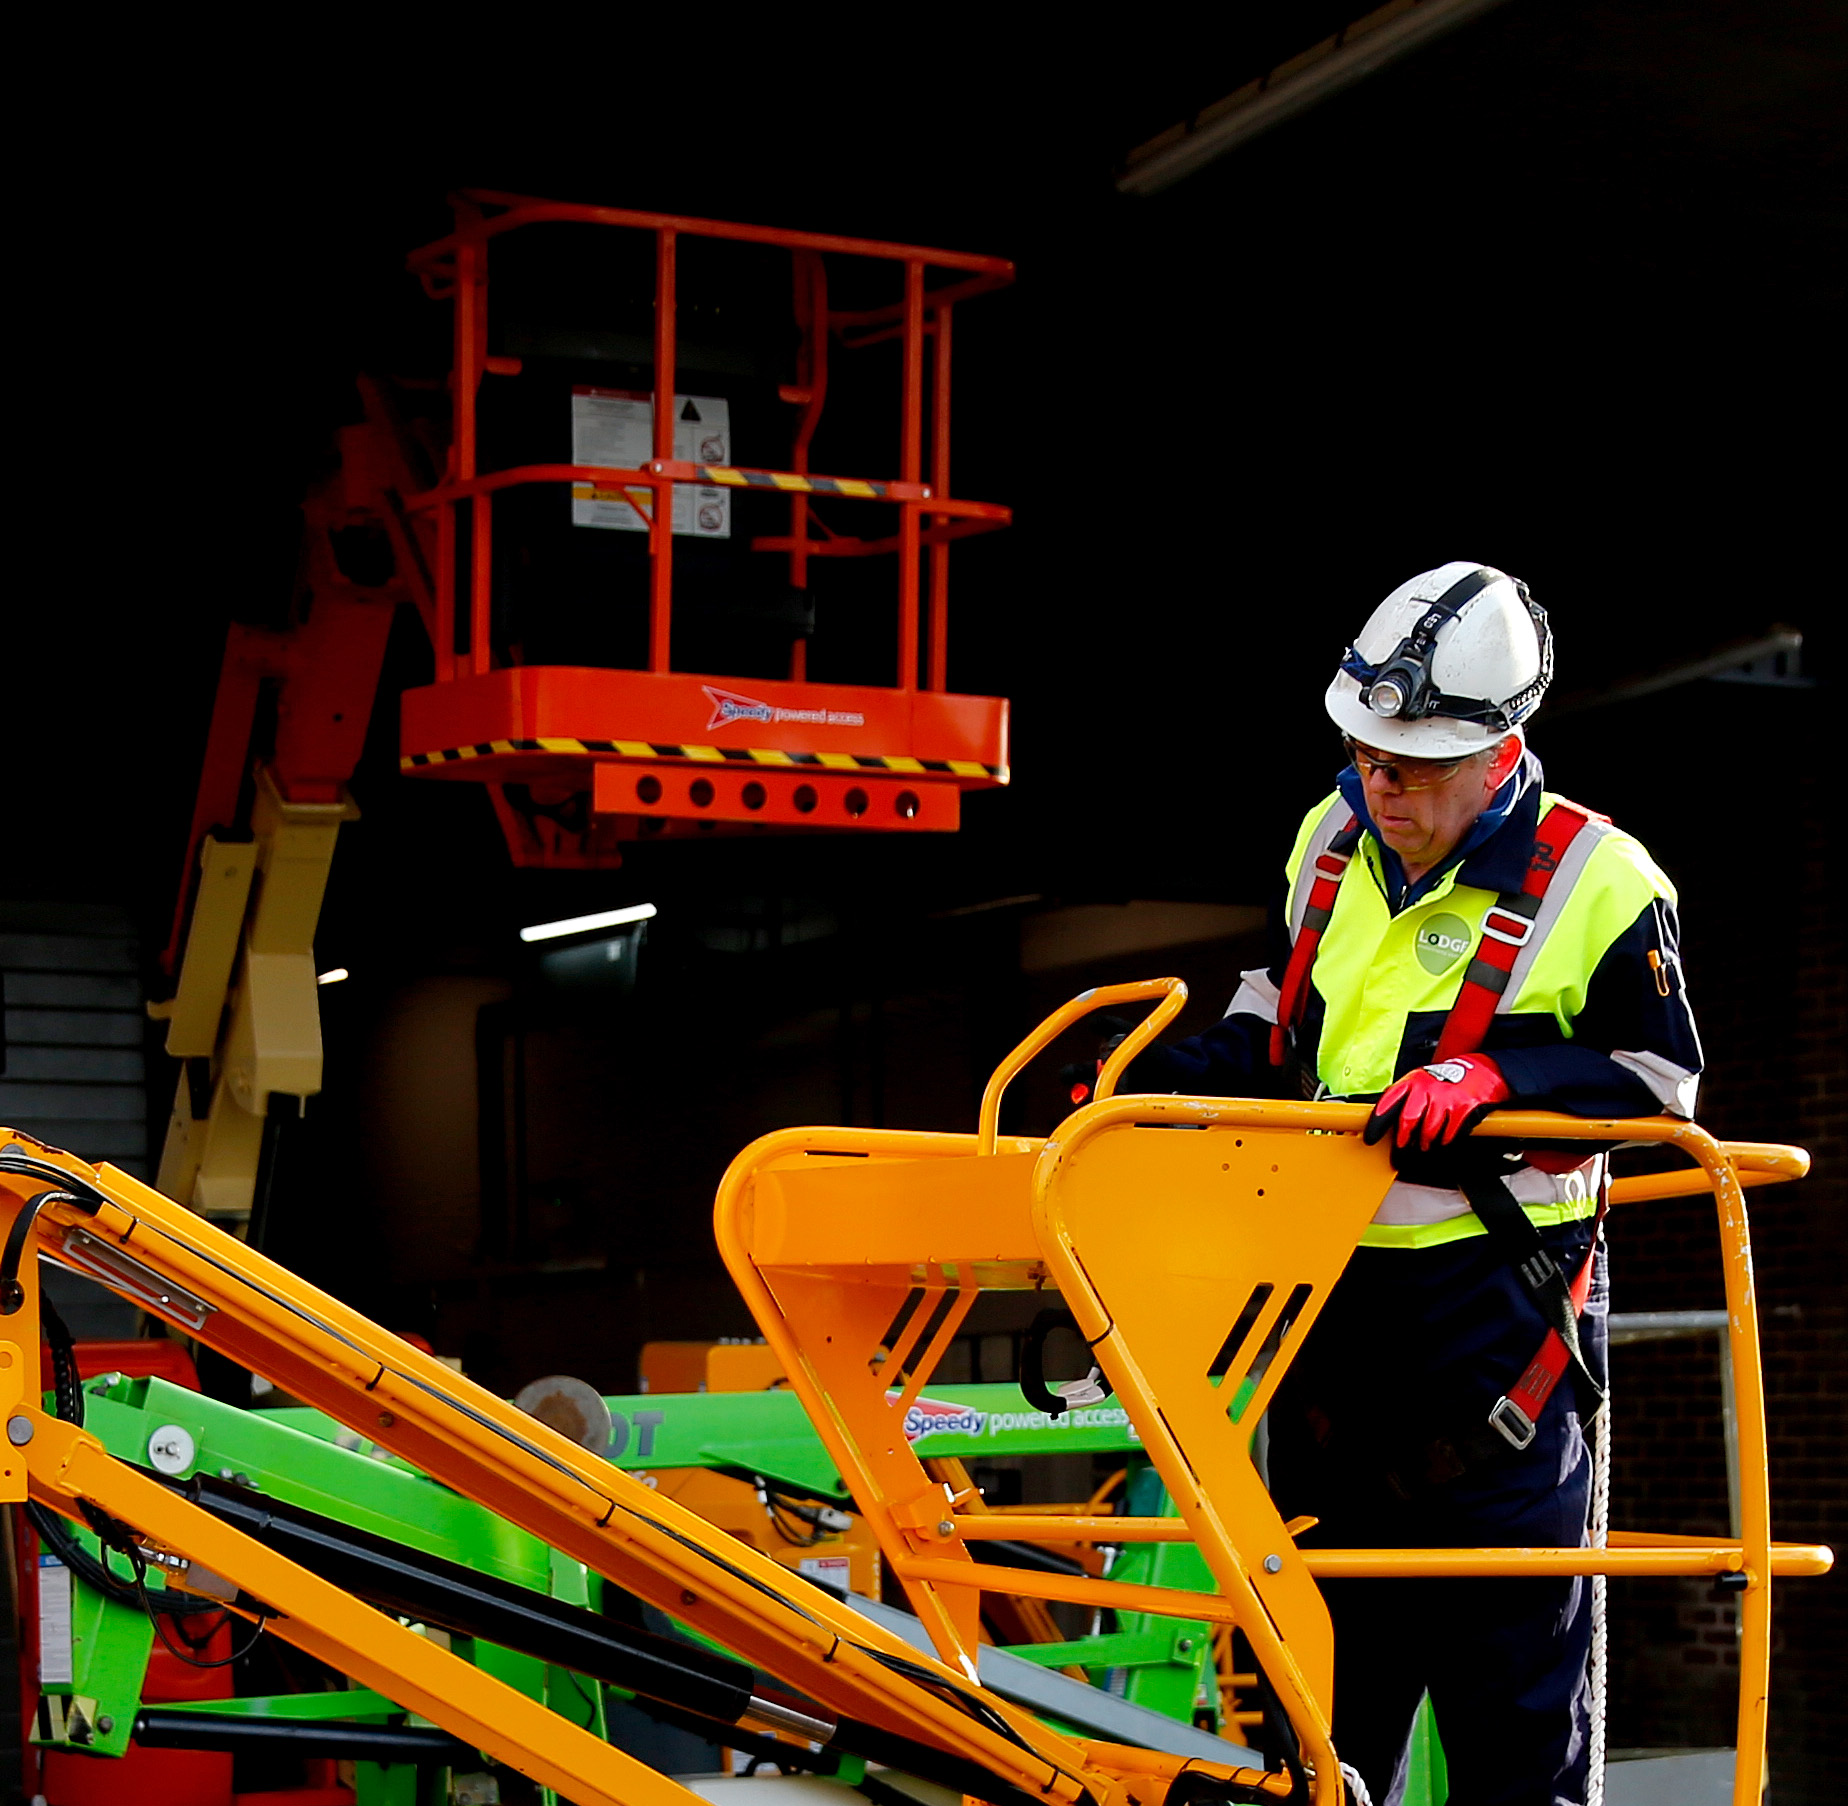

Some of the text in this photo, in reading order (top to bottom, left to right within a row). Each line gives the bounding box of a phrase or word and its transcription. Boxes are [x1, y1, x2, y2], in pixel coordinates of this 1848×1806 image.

[721, 700, 865, 727] Speedy powered access
[905, 1406, 1129, 1437] Speedy powered access
